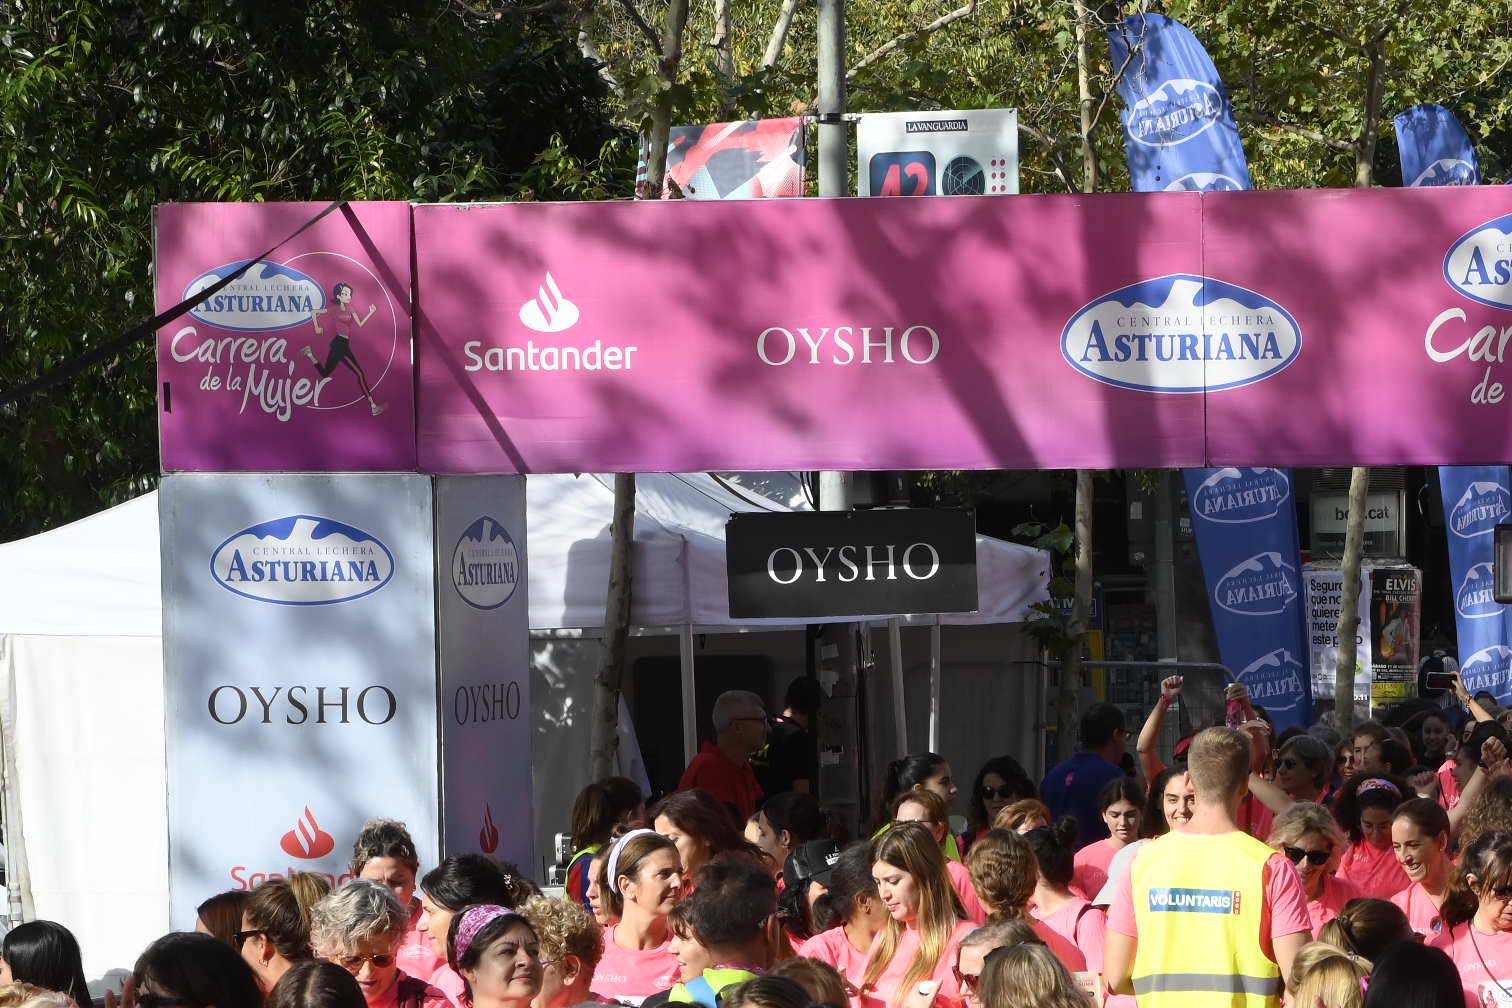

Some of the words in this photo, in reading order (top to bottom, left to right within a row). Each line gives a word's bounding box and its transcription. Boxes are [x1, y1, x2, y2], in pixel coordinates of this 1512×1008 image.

[1117, 316, 1191, 327] CENTRAL
[1200, 314, 1275, 326] LECHERA
[171, 326, 289, 363] Carrera
[464, 341, 638, 373] Santander
[756, 326, 940, 367] OYSHO
[1080, 319, 1283, 362] ASTURIANA
[200, 366, 221, 391] de
[226, 364, 241, 391] la
[239, 359, 333, 422] Mujer
[1471, 366, 1504, 404] de
[225, 548, 382, 582] ASTURIANA
[252, 546, 311, 556] CENTRAL
[316, 546, 375, 556] LECHERA
[457, 552, 515, 586] ASTURIANA
[767, 543, 940, 585] OYSHO
[1385, 578, 1416, 591] ELVIS
[208, 685, 397, 725] OYSHO
[454, 681, 521, 725] OYSHO
[1150, 893, 1231, 908] VOLUNTARIS
